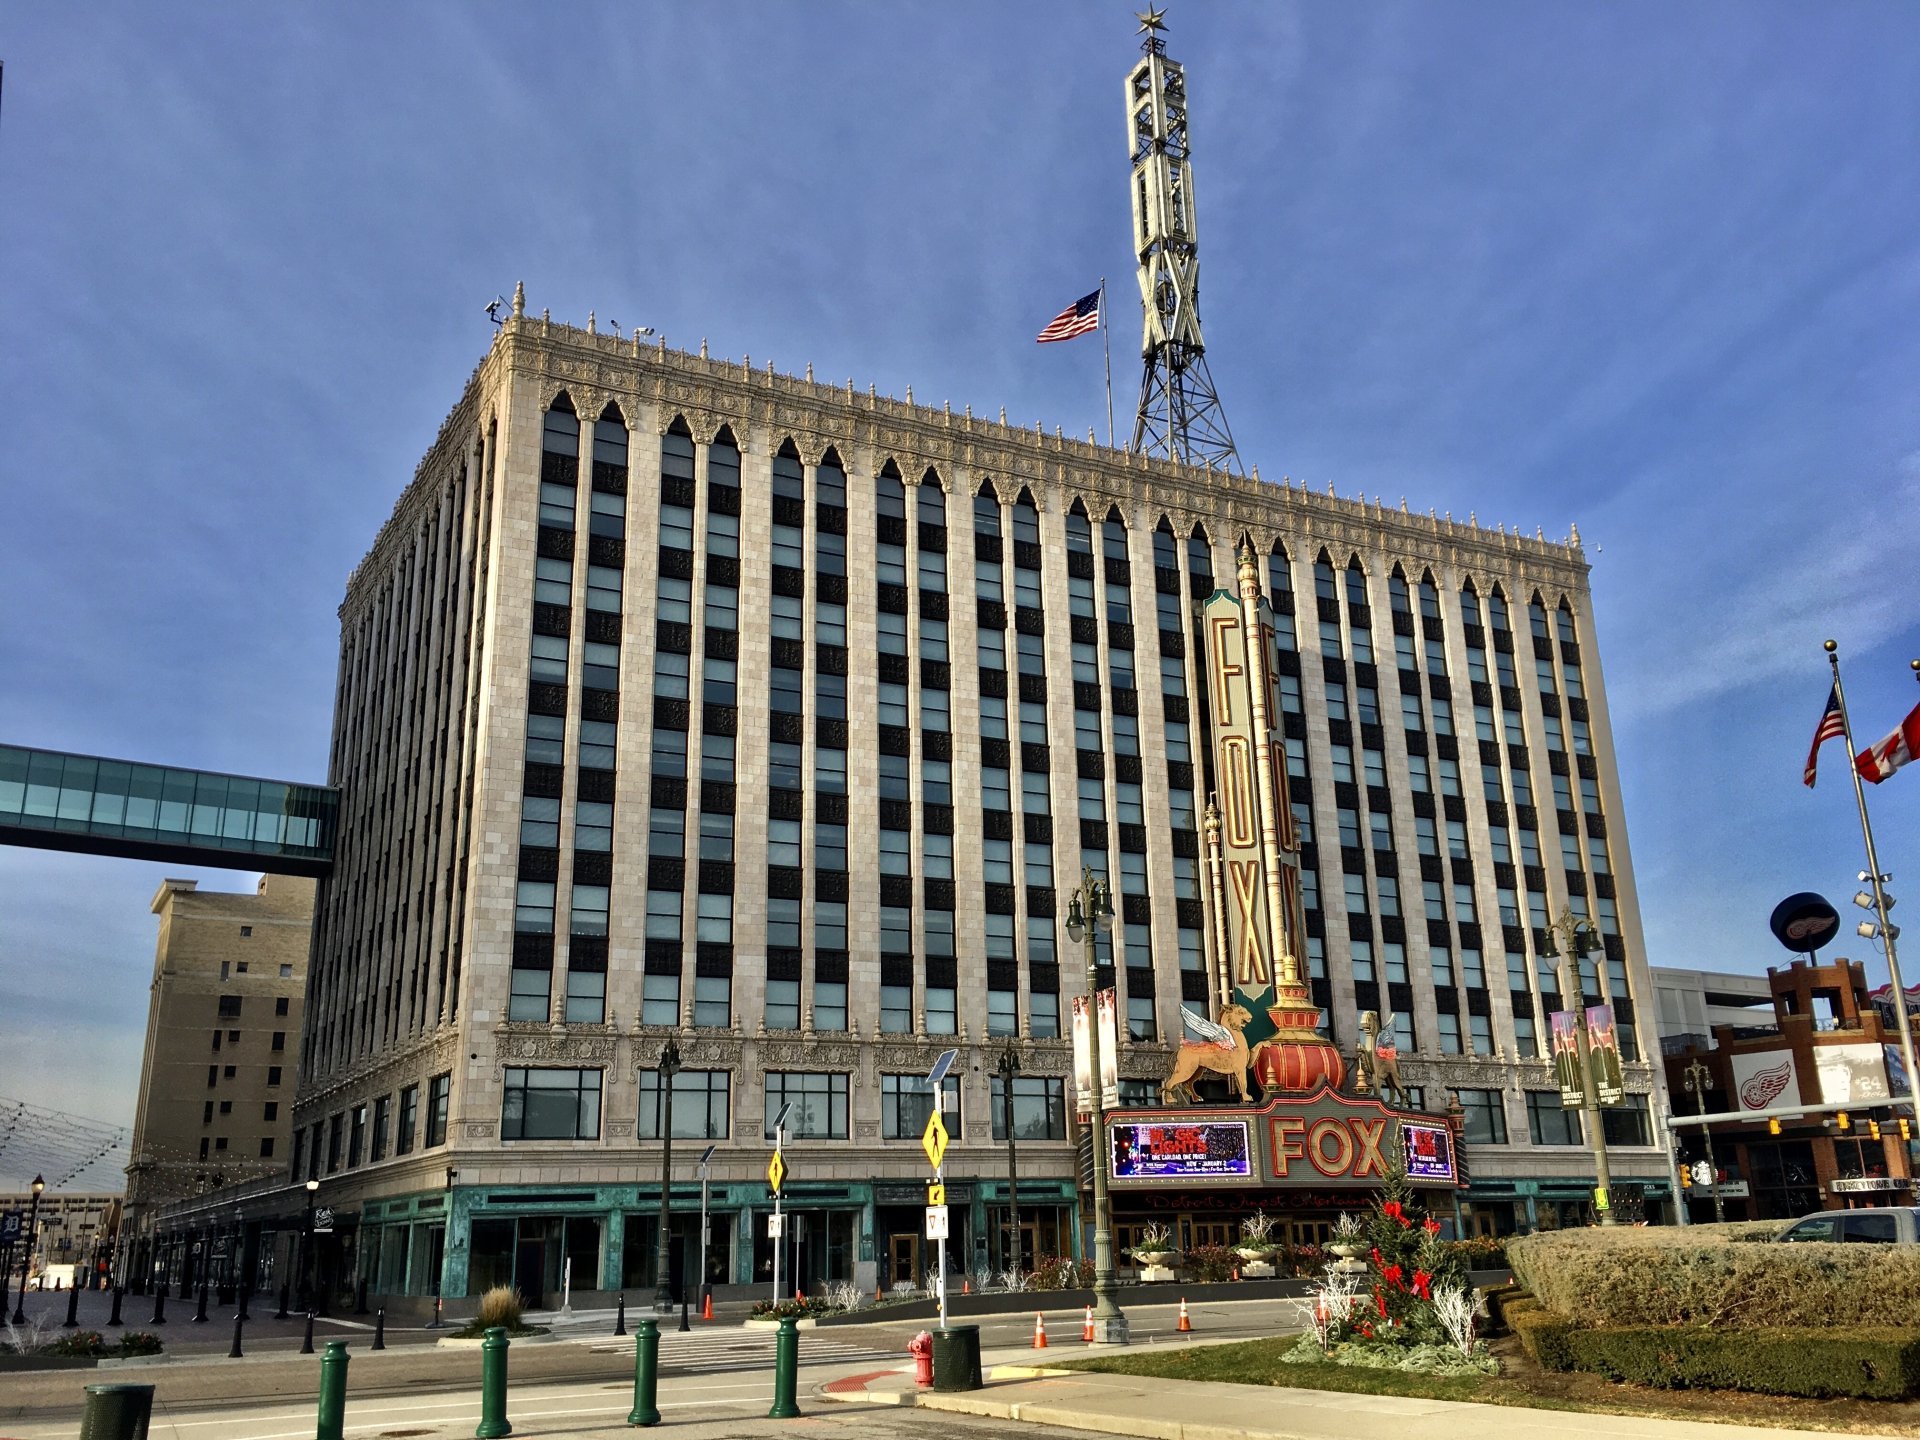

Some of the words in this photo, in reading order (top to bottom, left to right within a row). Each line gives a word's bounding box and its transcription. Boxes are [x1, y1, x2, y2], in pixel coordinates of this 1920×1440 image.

[1125, 57, 1167, 357] FOX
[1211, 616, 1270, 986] FOX
[1561, 1084, 1572, 1092] THE
[1597, 1081, 1609, 1089] THE
[1562, 1091, 1584, 1100] DISTRICT
[1599, 1087, 1622, 1097] DISTRICT
[1563, 1098, 1582, 1106] DETROIT
[1600, 1095, 1620, 1103] DETROIT
[1150, 1140, 1208, 1154] LIGHTS
[1270, 1117, 1389, 1177] FOX
